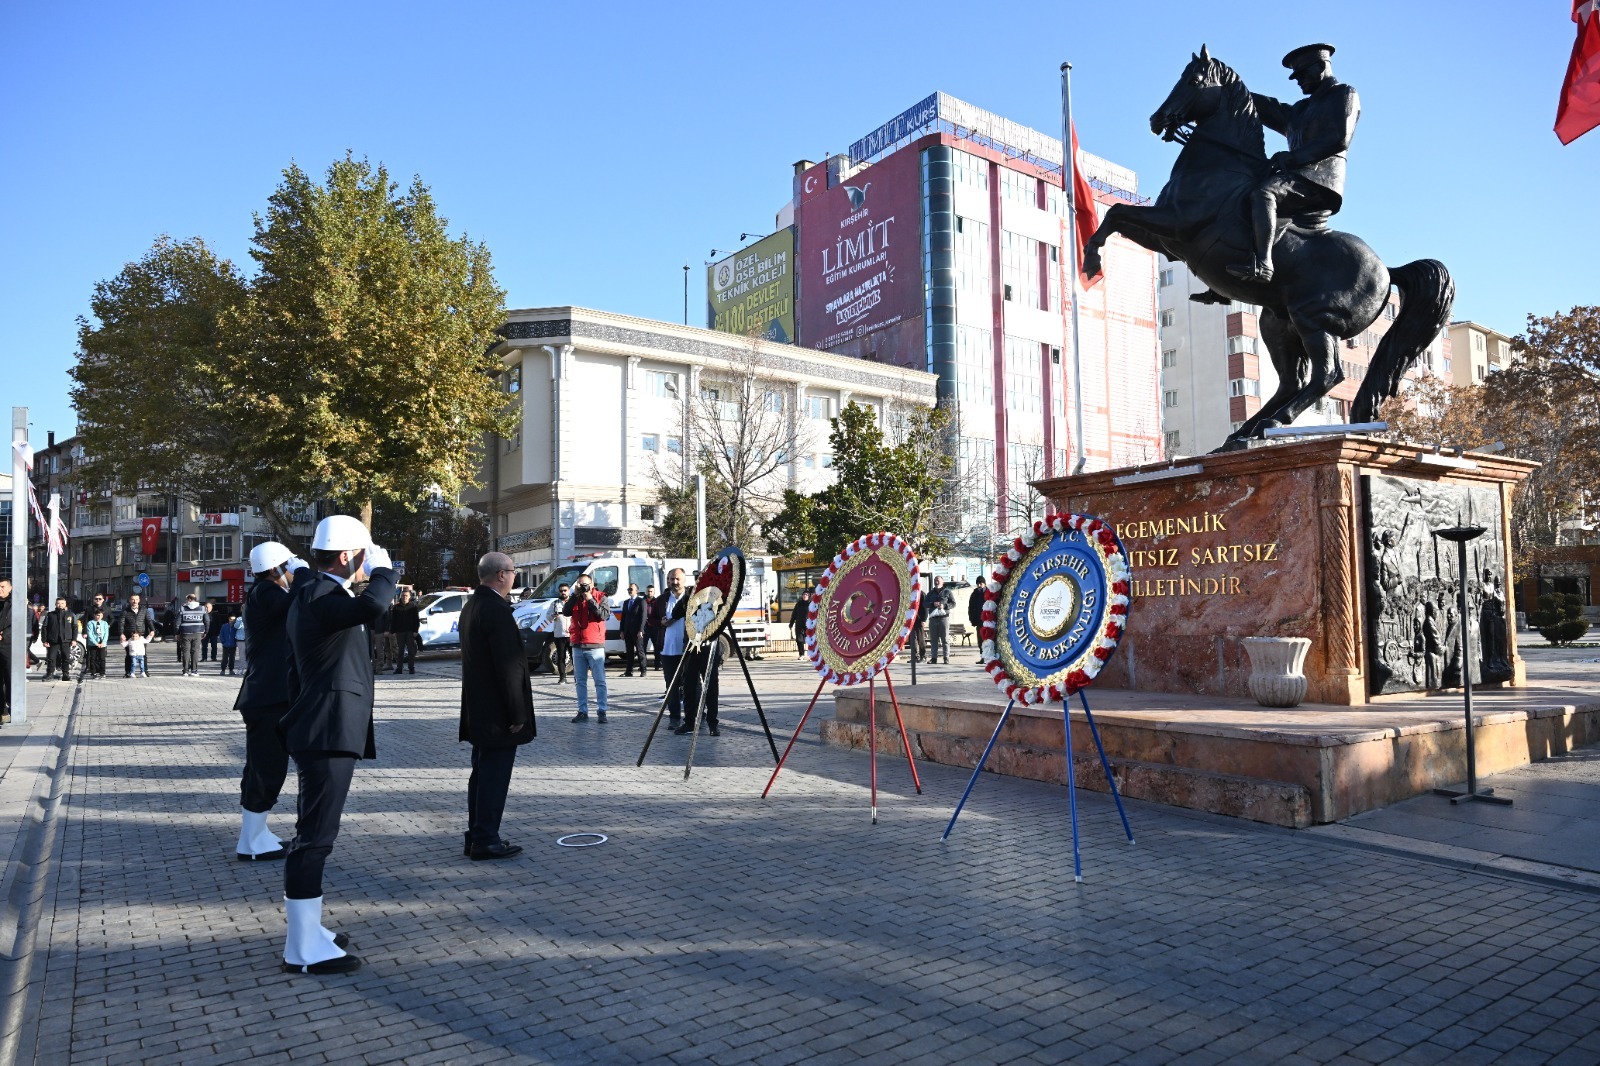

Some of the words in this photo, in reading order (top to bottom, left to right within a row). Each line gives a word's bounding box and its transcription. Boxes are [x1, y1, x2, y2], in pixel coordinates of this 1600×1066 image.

[907, 104, 936, 131] KURS
[840, 208, 869, 229] KIRŞEHİR
[821, 215, 895, 276] LİMİT
[736, 252, 760, 271] ÖZEL
[736, 266, 755, 283] OSB
[757, 250, 786, 273] BİLİM
[825, 270, 848, 285] EĞİTİM
[848, 250, 887, 275] KURUMLARI
[716, 280, 750, 304] TEKNİK
[752, 262, 786, 288] KOLEJİ
[746, 281, 781, 311] DEVLET
[747, 295, 789, 330] DESTEKLİ
[1115, 511, 1227, 540] EGEMENLİK
[1031, 554, 1090, 581] KIRŞEHİR
[1129, 548, 1179, 568] ITSIZ
[1191, 543, 1278, 568] ŞARTSIZ
[190, 569, 220, 577] ECZANE
[1015, 589, 1037, 658] BELEDİYE
[1038, 588, 1096, 662] BAŞKANLIĞI
